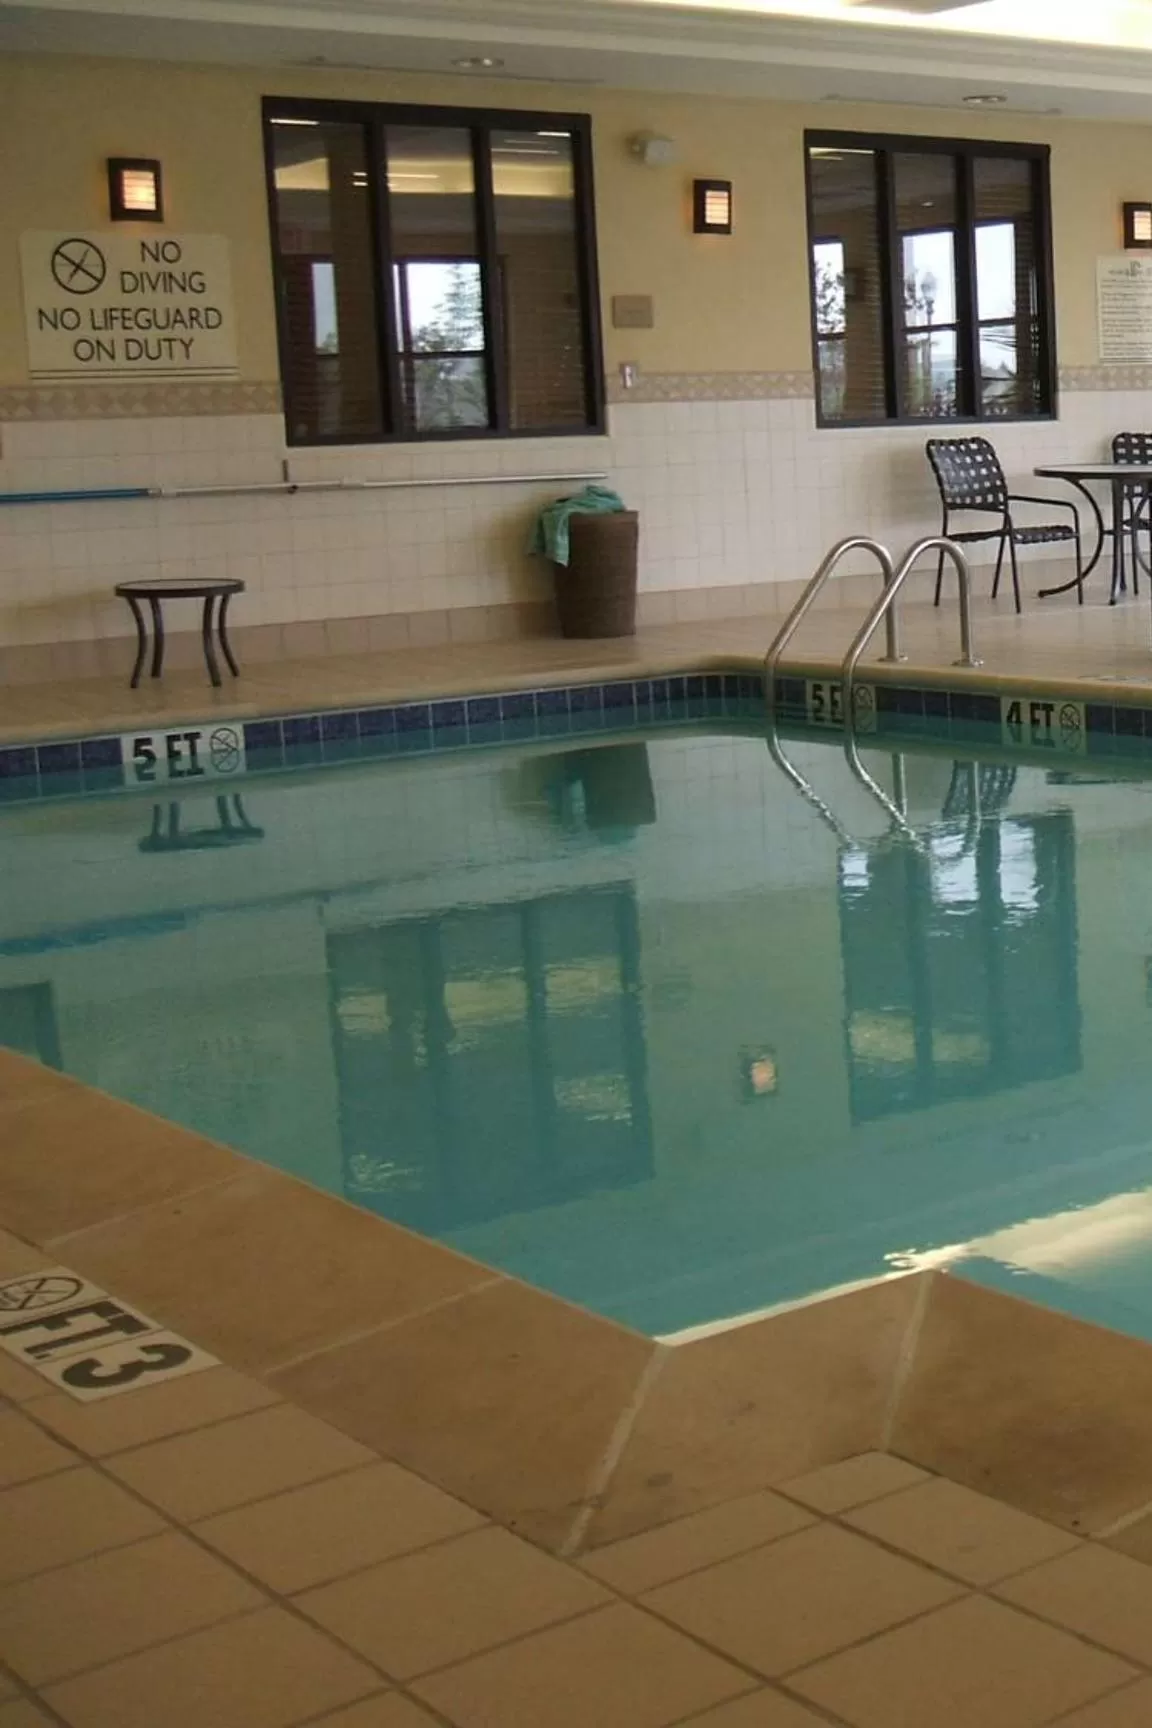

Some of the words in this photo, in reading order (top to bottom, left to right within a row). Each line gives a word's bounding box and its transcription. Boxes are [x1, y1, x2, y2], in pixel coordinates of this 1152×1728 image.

[140, 241, 182, 264] NO
[119, 271, 207, 294] DIVING
[37, 308, 81, 331] NO
[90, 307, 223, 331] LIFEGUARD
[73, 338, 116, 362] ON
[125, 338, 195, 361] DUTY
[1006, 701, 1024, 737] 4
[1029, 702, 1055, 739] FT
[133, 737, 156, 773] 5
[166, 732, 203, 769] FT
[0, 1300, 152, 1359] FT
[61, 1343, 193, 1389] 3
